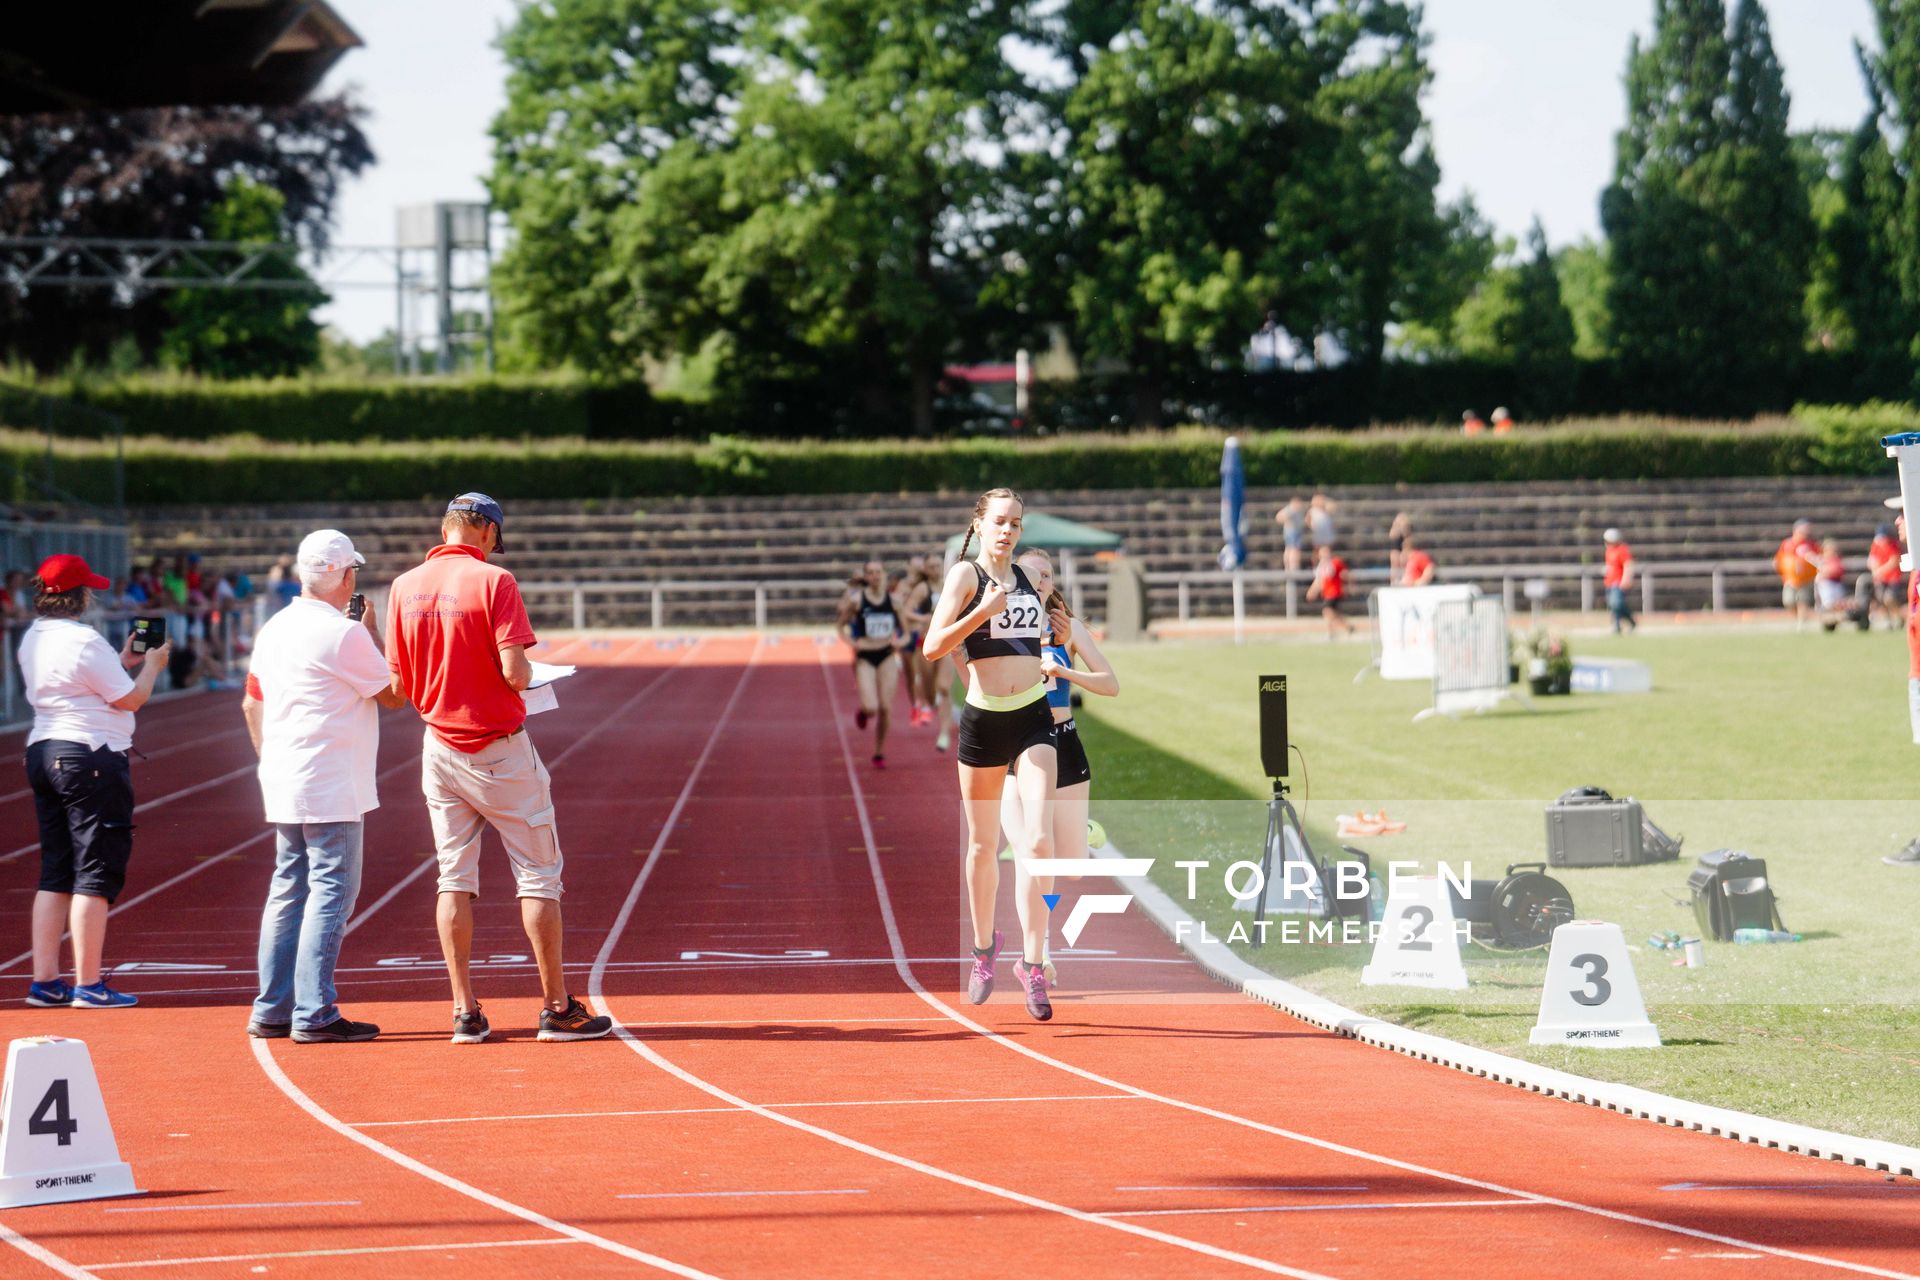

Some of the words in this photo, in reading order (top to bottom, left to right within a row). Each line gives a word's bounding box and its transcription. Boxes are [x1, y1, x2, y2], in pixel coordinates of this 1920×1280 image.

[998, 606, 1039, 630] 322
[1260, 680, 1286, 692] ALGE
[1398, 905, 1434, 952] 2
[1569, 953, 1612, 1007] 3
[28, 1078, 78, 1147] 4
